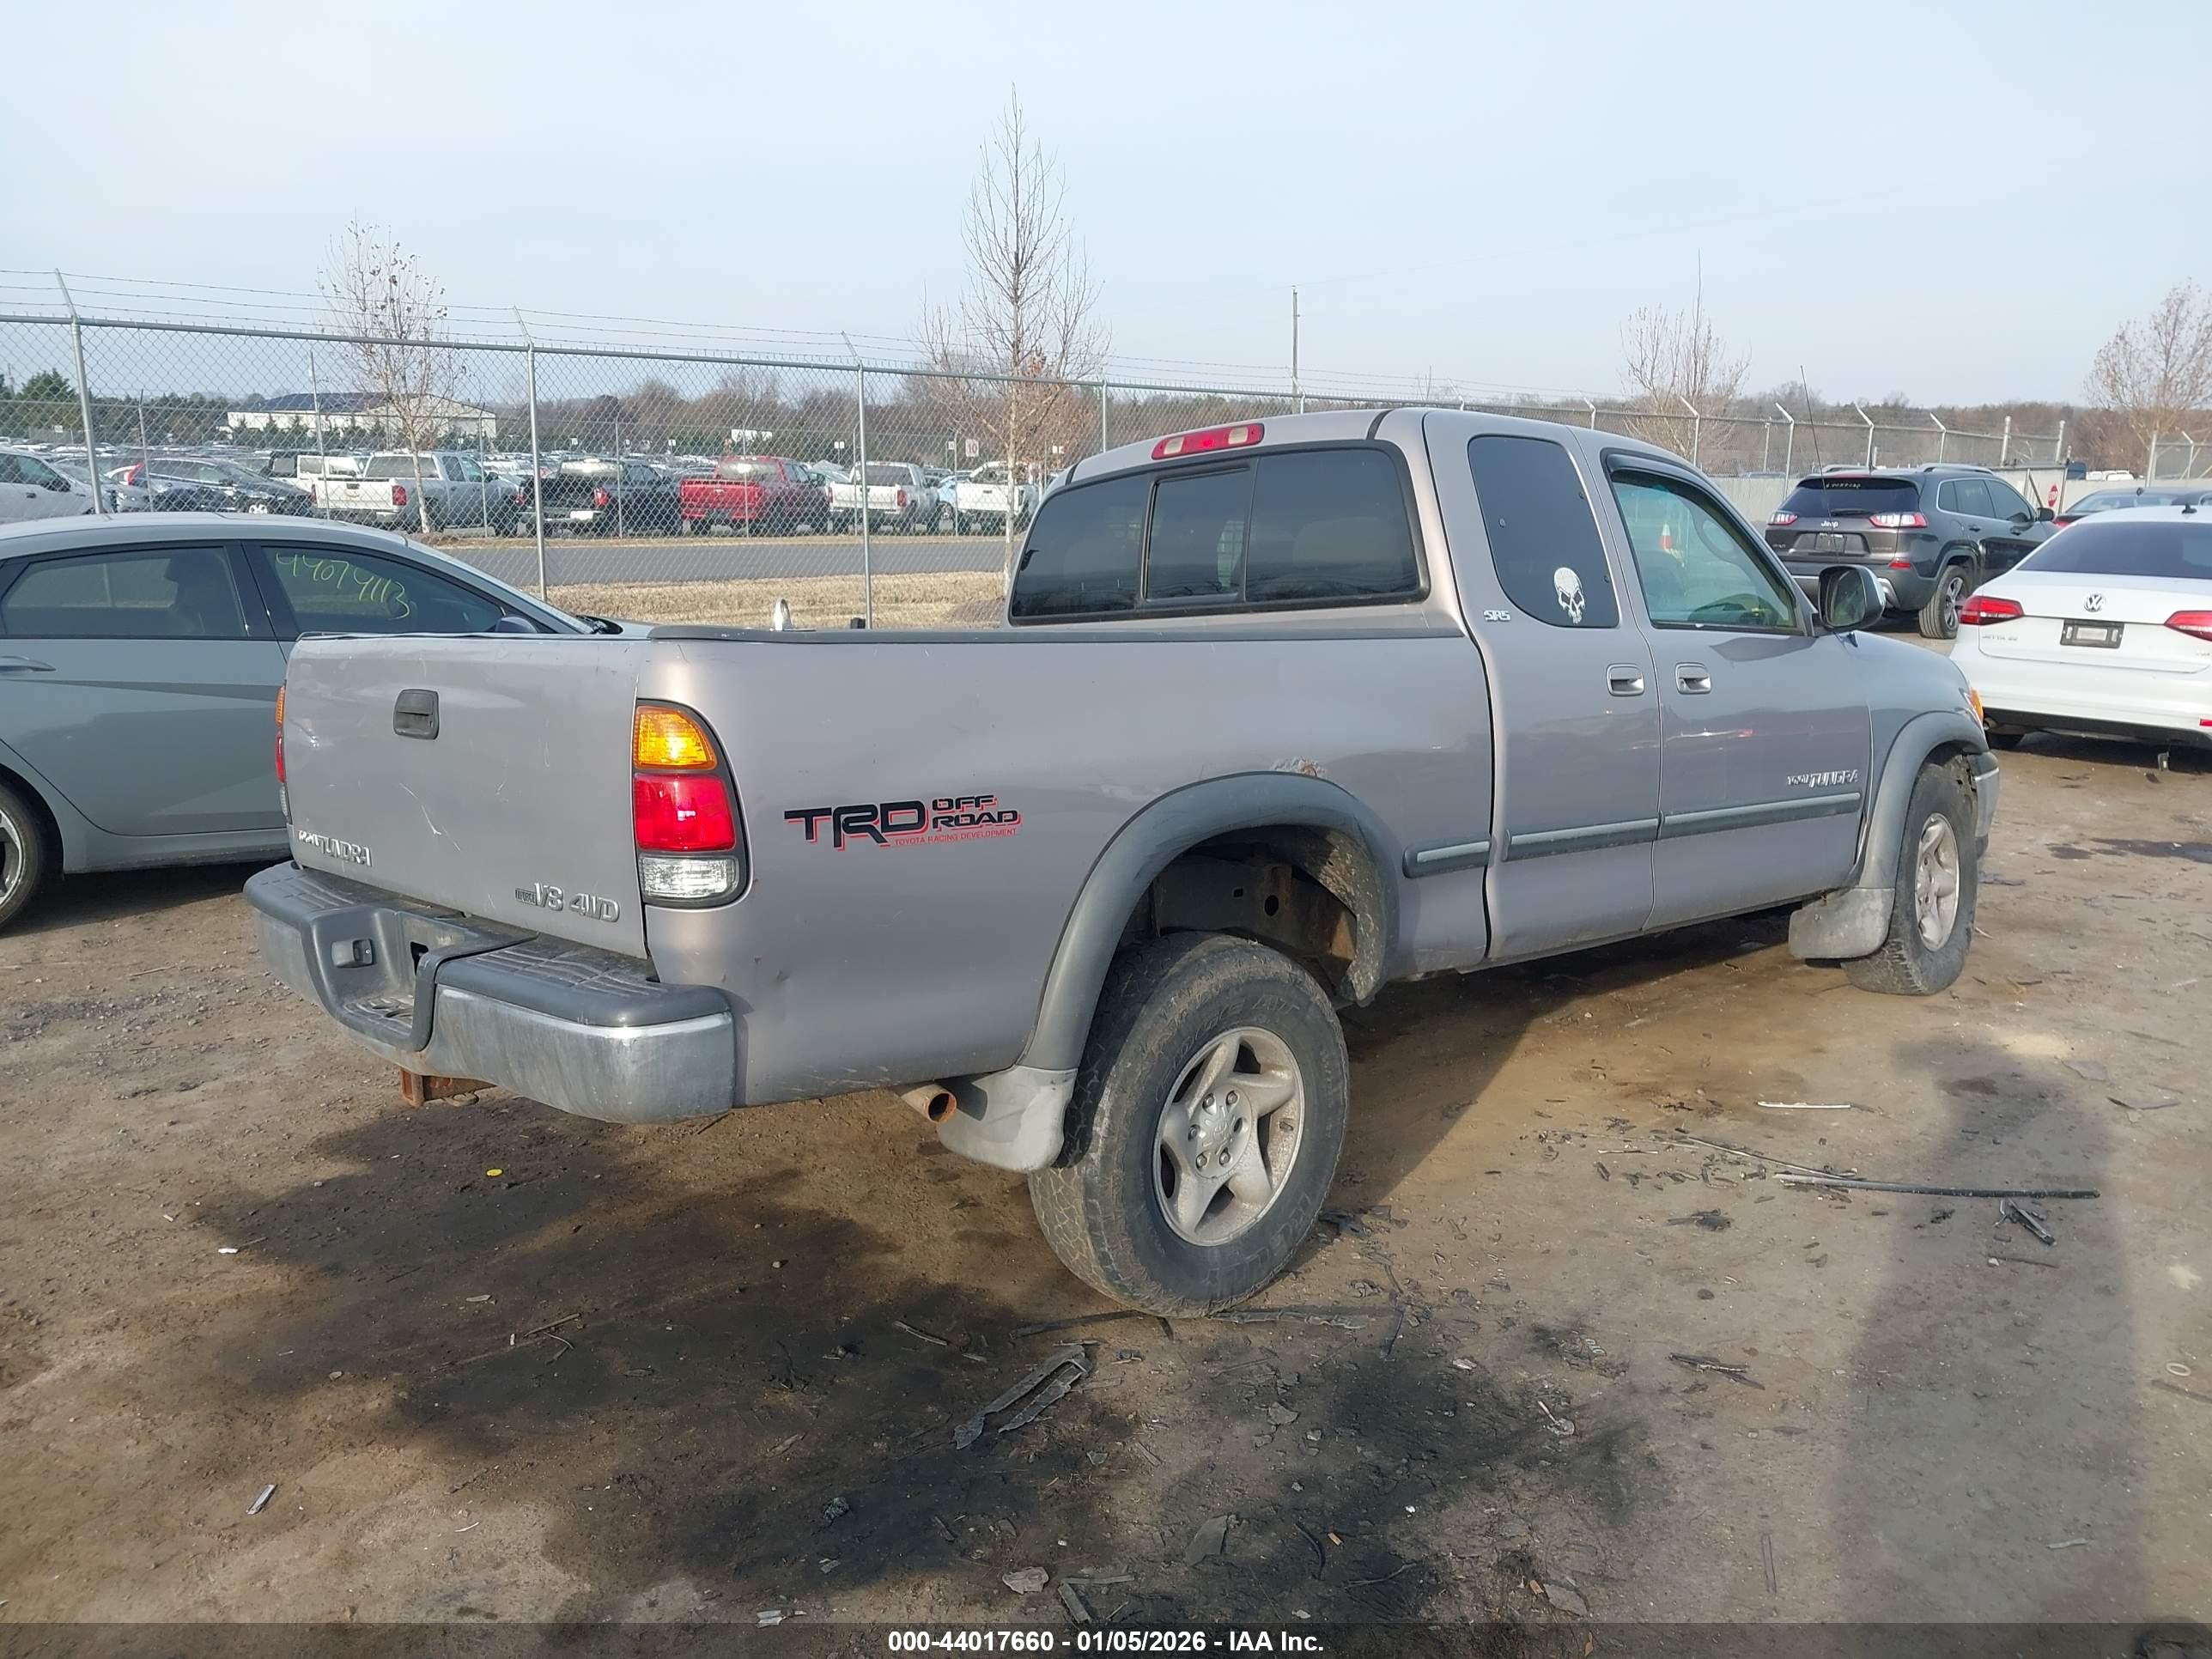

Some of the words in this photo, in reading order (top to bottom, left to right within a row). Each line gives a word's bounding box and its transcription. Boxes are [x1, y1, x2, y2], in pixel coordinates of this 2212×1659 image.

[932, 795, 997, 813] OFF
[784, 800, 928, 852] TRD
[932, 810, 1021, 831] ROAD
[895, 836, 926, 846] TOYOTA
[927, 833, 958, 844] RACING
[960, 828, 1018, 840] DEVELOPMENT
[319, 834, 372, 867] TUNDRA
[534, 881, 564, 911] V8
